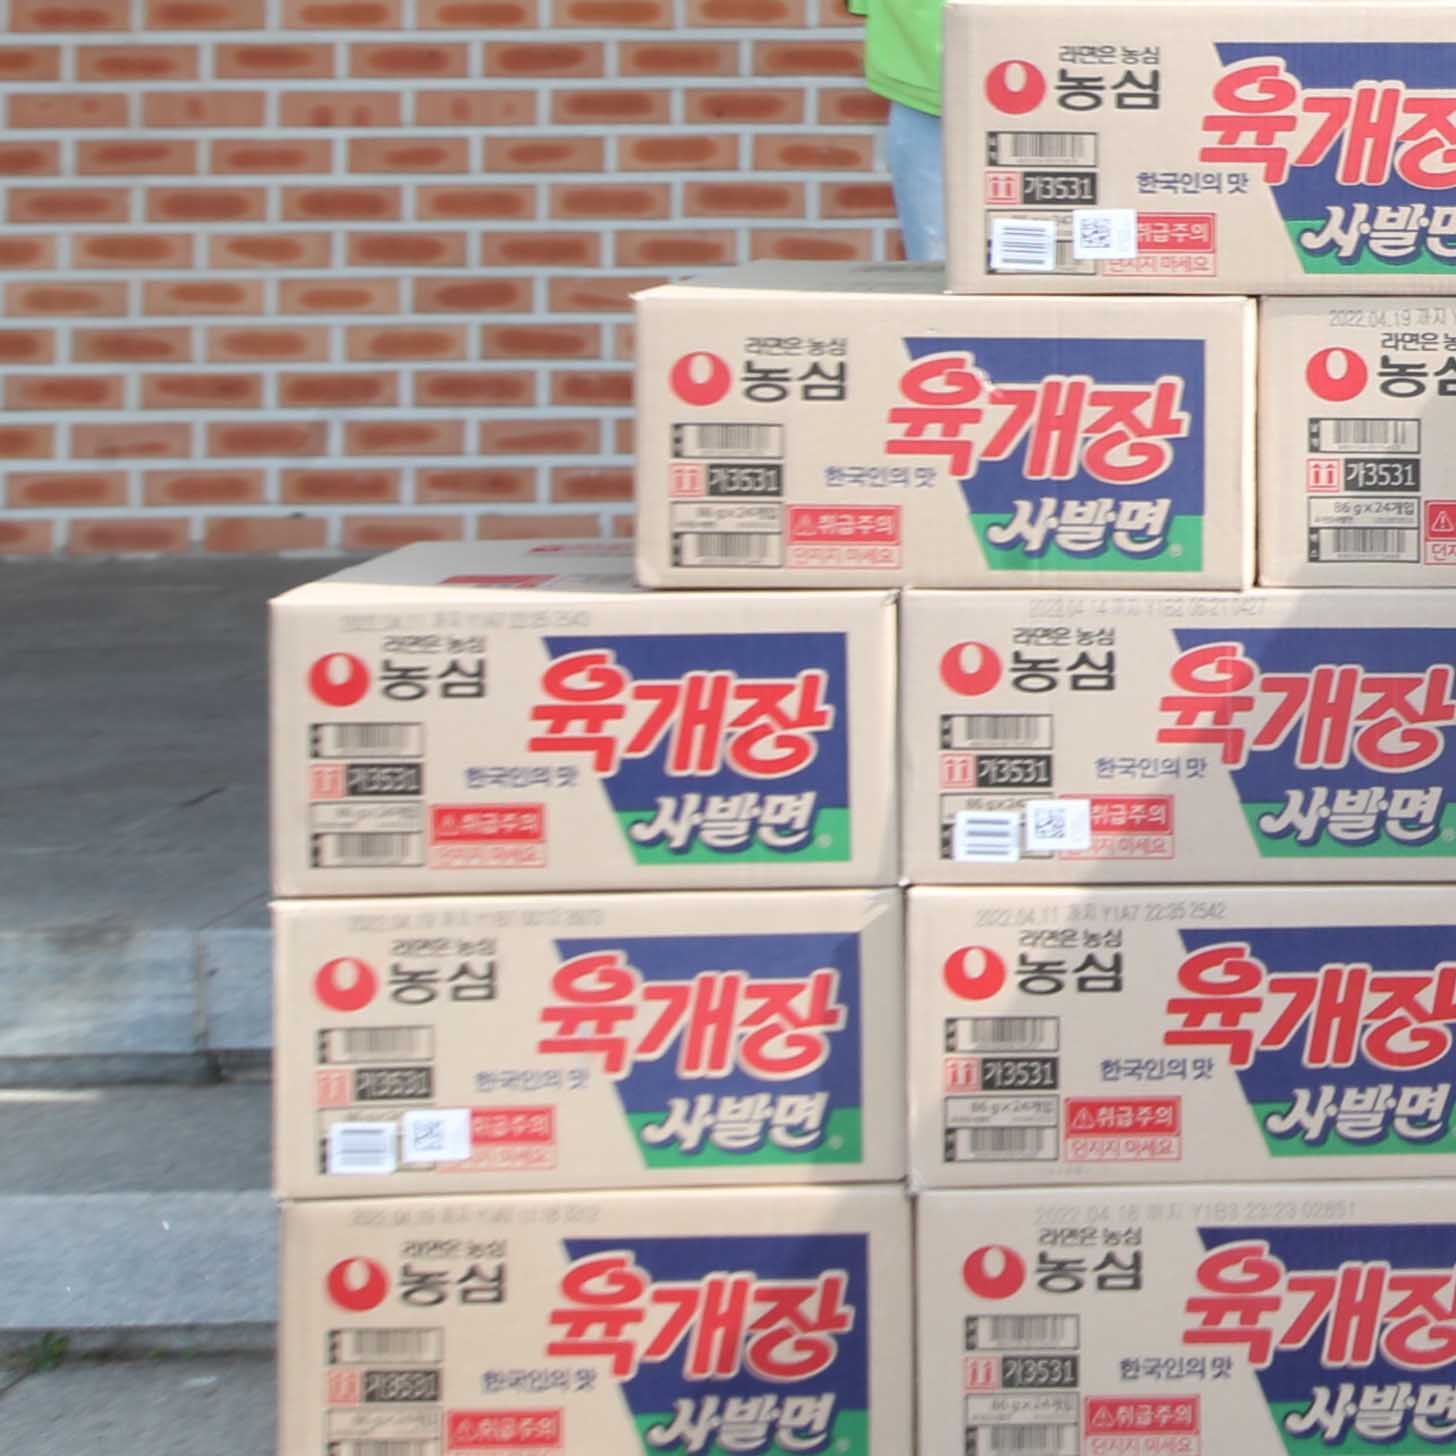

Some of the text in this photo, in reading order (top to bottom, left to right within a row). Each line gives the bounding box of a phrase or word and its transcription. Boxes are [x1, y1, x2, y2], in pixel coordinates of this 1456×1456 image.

[1054, 68, 1161, 111] 농심
[740, 359, 847, 403] 농심
[885, 353, 1187, 484] 육개장
[1346, 461, 1416, 488] 가3531
[986, 496, 1172, 557] 사발면
[378, 658, 487, 702] 농심
[1009, 650, 1116, 693] 농심
[526, 650, 832, 778] 육개장
[630, 792, 818, 851] 사발면
[1258, 785, 1444, 845] 사발면
[388, 961, 497, 1005] 농심
[1014, 952, 1123, 996] 농심
[536, 949, 843, 1080] 육개장
[642, 1092, 831, 1154] 사발면
[1266, 1084, 1453, 1143] 사발면
[398, 1262, 507, 1307] 농심
[1034, 1251, 1143, 1294] 농심
[545, 1251, 851, 1382] 육개장
[648, 1395, 836, 1456] 사발면
